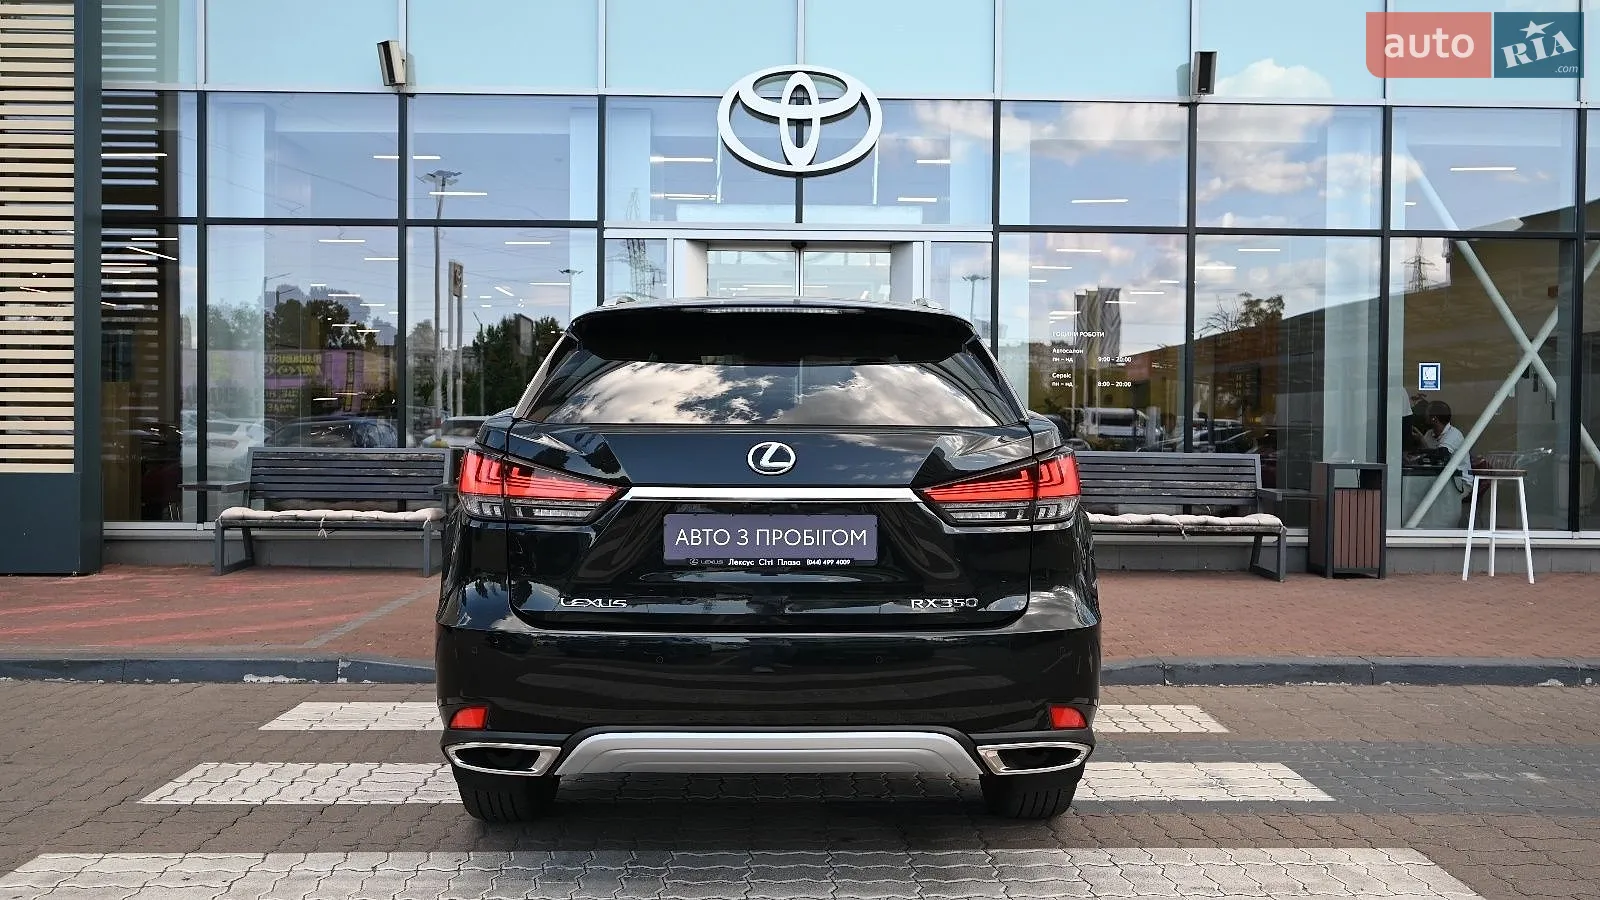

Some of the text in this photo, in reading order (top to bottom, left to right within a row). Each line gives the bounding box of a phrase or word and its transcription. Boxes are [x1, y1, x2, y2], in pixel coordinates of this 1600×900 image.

[674, 528, 867, 546] АВТО З ПРОБІГОМ
[727, 558, 755, 567] Лексус
[758, 558, 774, 566] Сіті
[777, 558, 801, 566] Плаза
[806, 558, 822, 566] (044)
[835, 558, 851, 566] 4009
[560, 597, 628, 608] LEXUS
